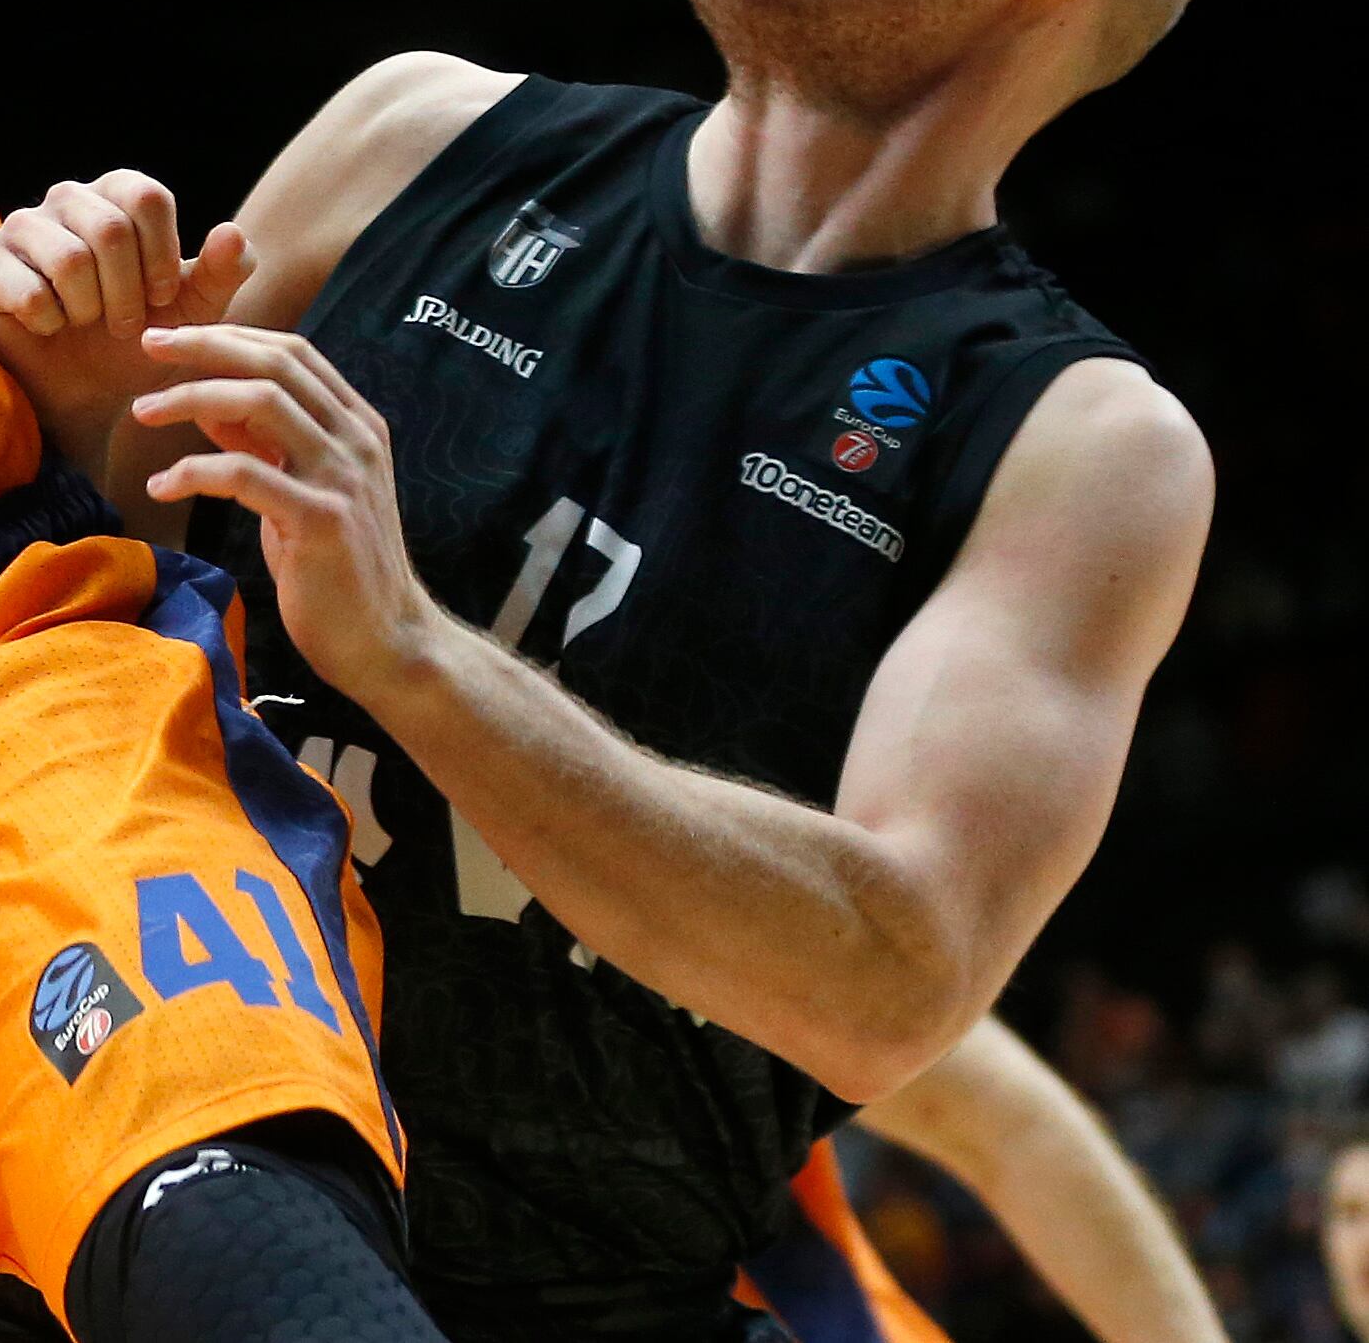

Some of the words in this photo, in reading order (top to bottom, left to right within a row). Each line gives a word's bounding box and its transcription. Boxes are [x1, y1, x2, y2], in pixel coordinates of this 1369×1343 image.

[403, 294, 545, 380] SPALDING
[833, 406, 902, 450] EuroCup
[744, 456, 903, 558] 10oneteam
[135, 867, 343, 1038] 41
